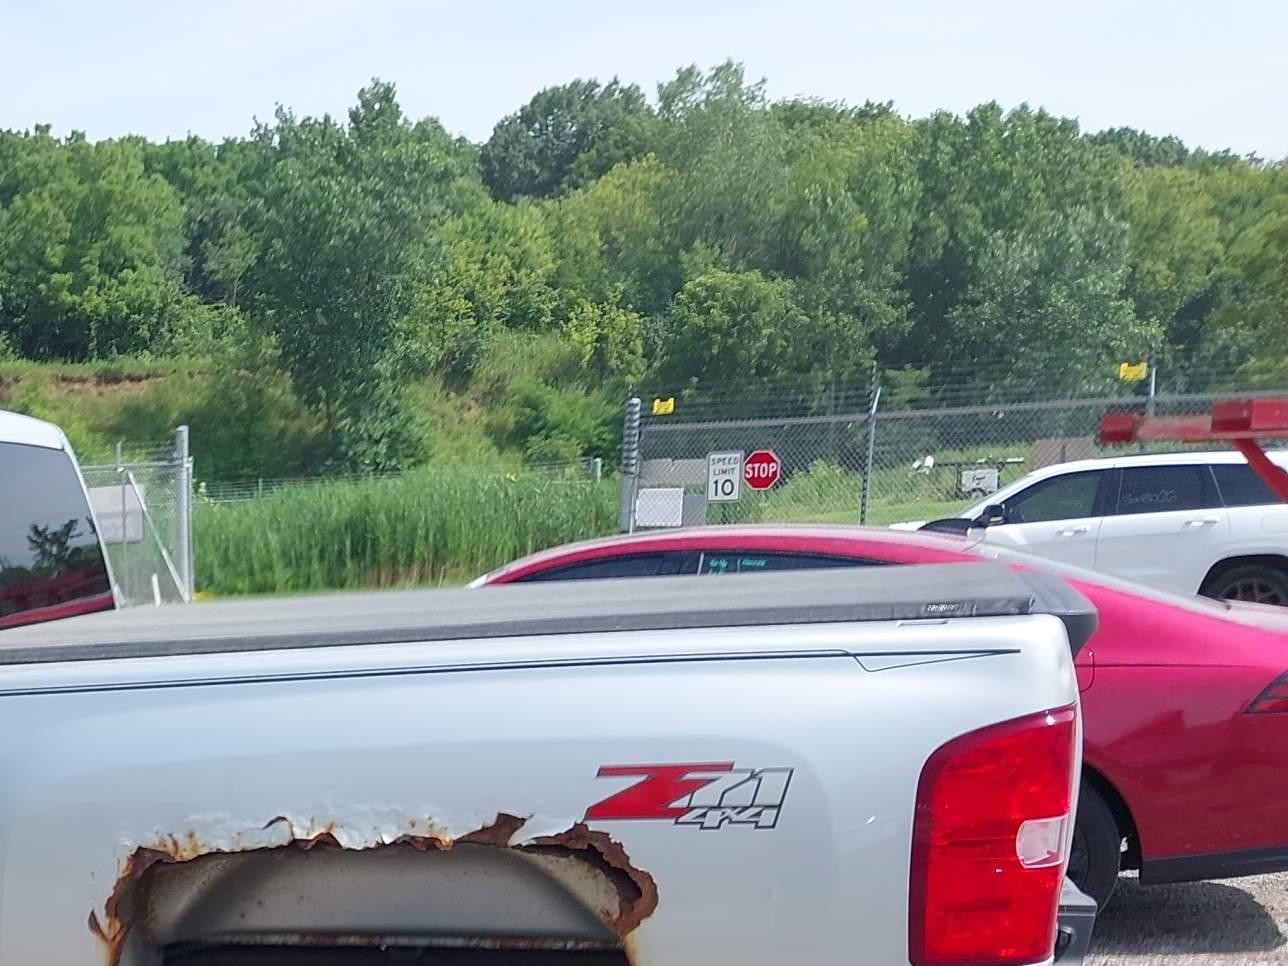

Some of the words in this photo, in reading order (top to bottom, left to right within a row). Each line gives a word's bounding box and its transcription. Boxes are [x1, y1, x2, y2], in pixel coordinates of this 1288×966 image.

[711, 456, 739, 465] SPEED
[713, 467, 735, 476] LIMIT
[745, 462, 777, 478] STOP
[713, 478, 734, 496] 10
[584, 762, 794, 821] Z71
